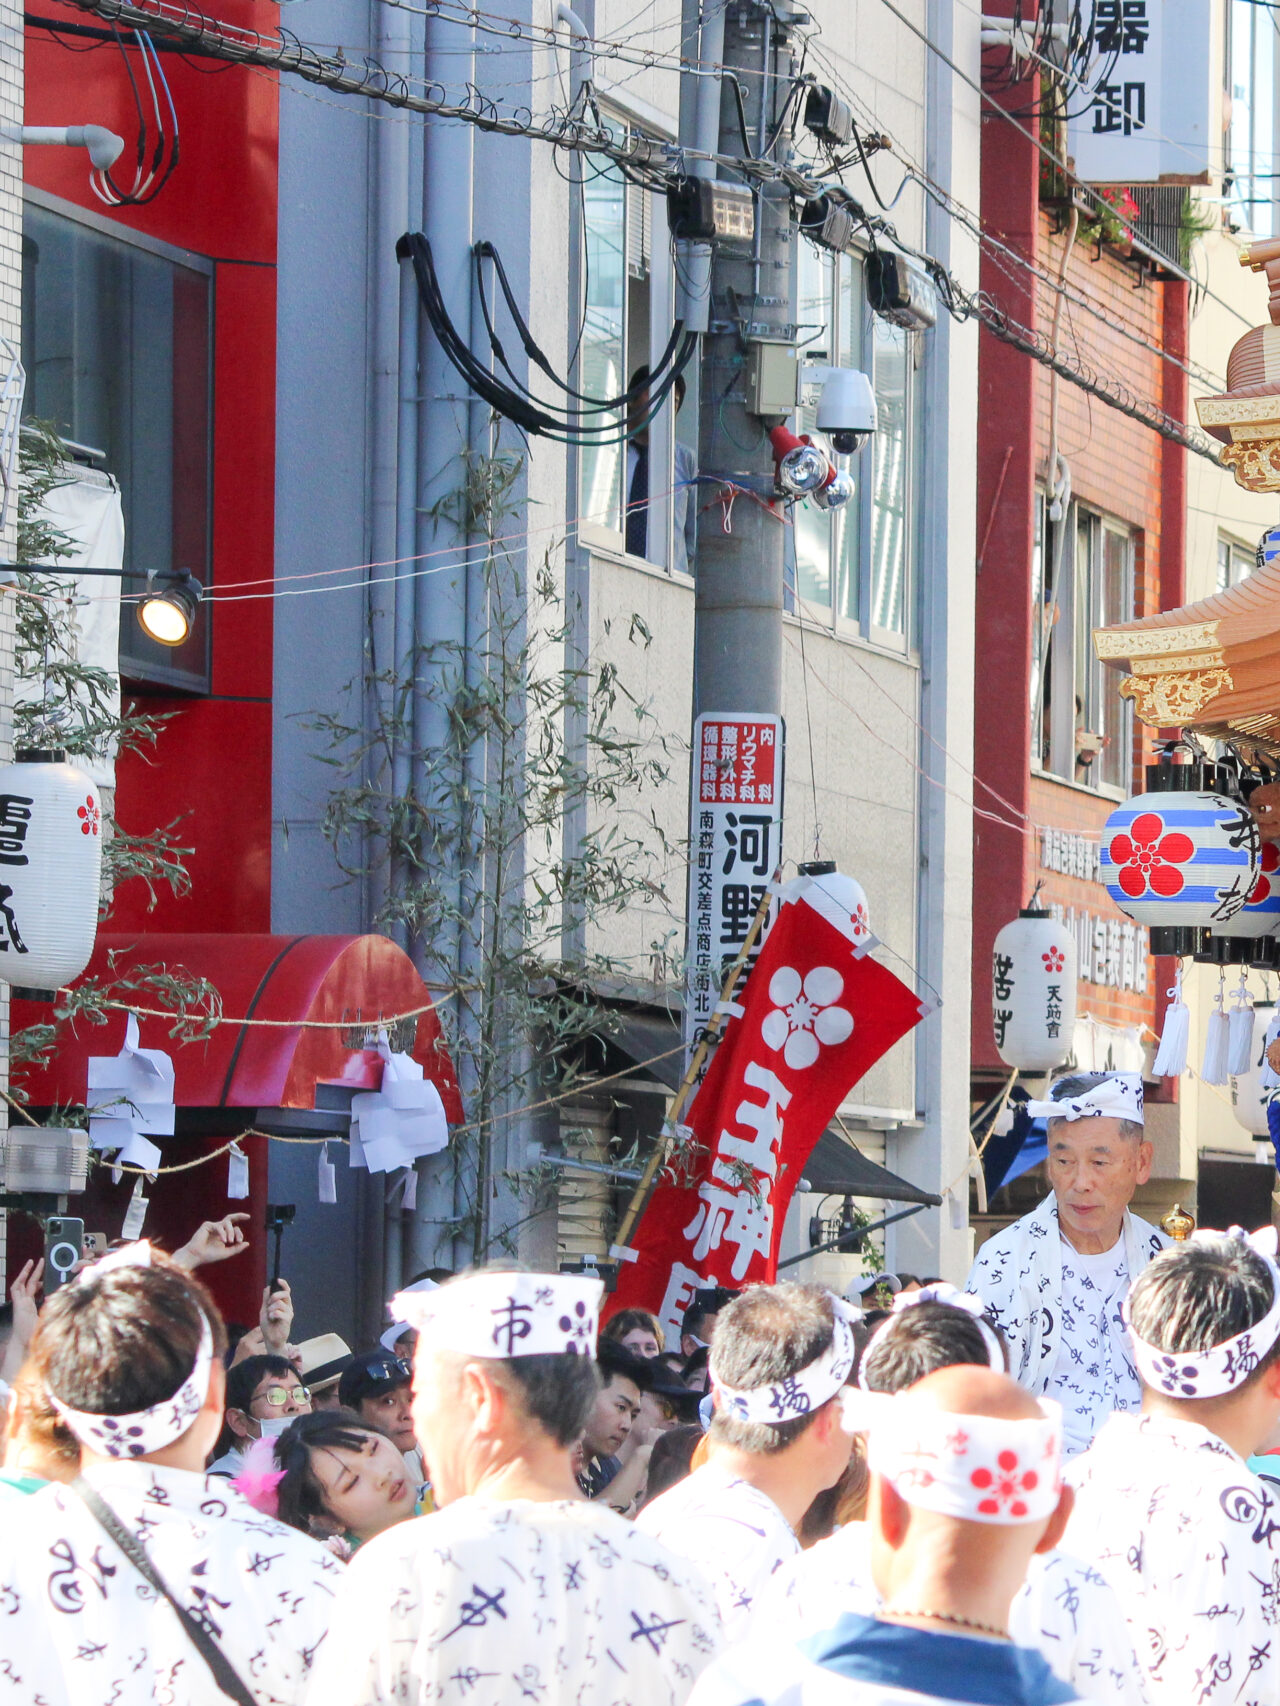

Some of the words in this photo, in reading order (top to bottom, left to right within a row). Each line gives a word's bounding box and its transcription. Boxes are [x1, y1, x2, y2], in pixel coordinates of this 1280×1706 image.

[720, 726, 738, 801] 整形外科
[740, 726, 757, 802] リウマチ科
[758, 727, 774, 802] 内科
